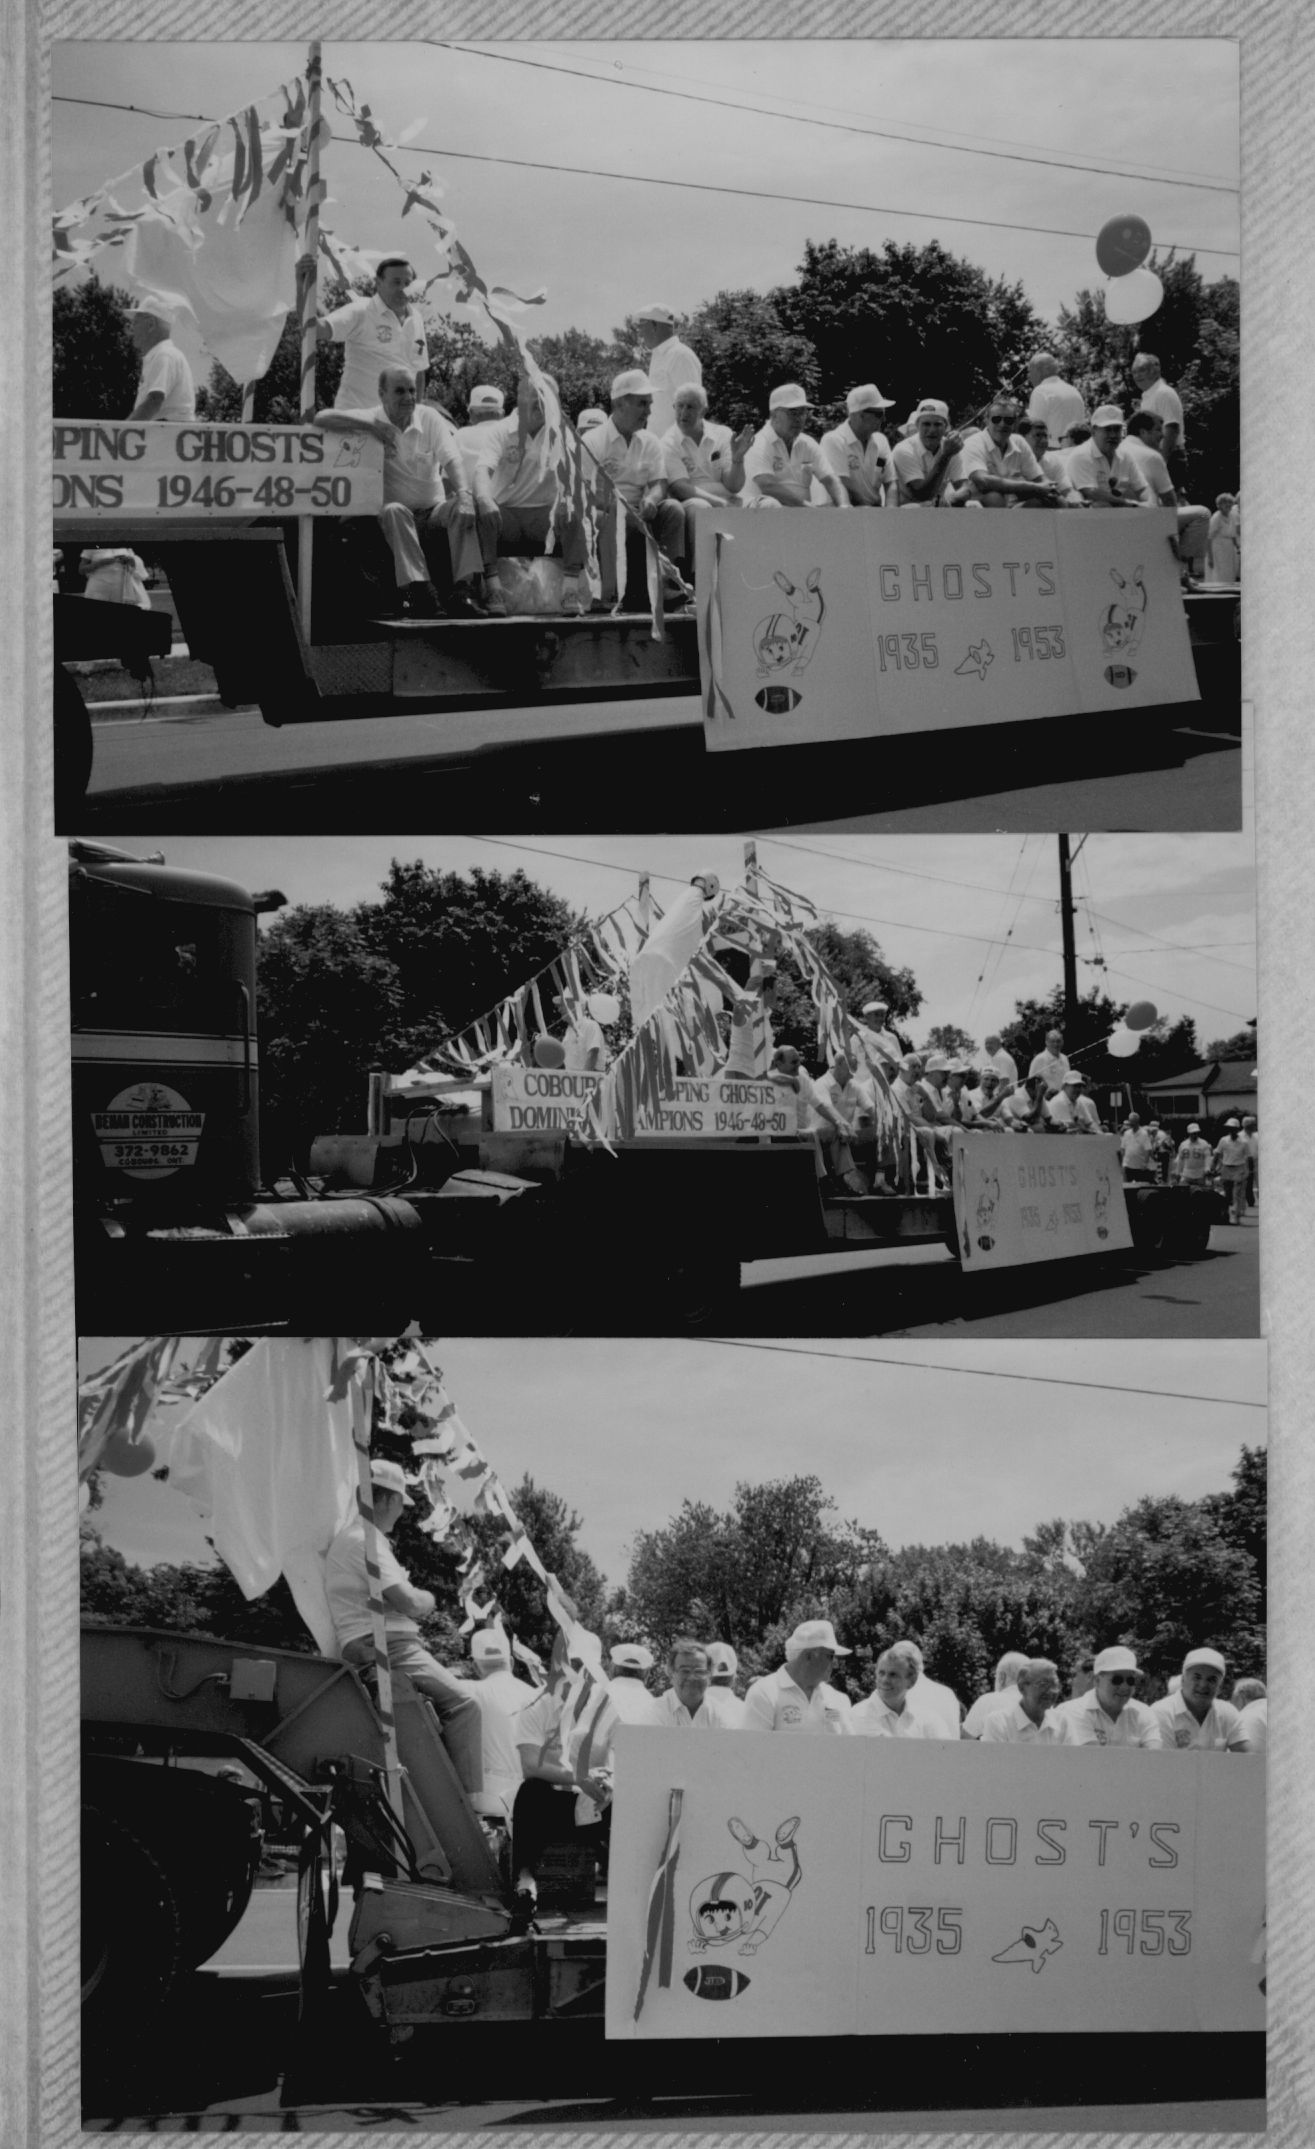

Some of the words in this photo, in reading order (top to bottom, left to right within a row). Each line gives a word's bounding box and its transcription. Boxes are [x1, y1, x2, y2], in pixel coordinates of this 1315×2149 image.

[53, 426, 147, 461] PING
[175, 429, 324, 463] GHOSTS
[157, 475, 352, 508] 1946-48-50
[878, 561, 1057, 602] GHOST'S
[876, 632, 940, 673] 1935
[1010, 625, 1067, 662] 1953
[719, 1083, 776, 1104] GHOSTS
[132, 1114, 202, 1128] CONSTRUCTION
[714, 1111, 786, 1132] 1946-48-50
[114, 1144, 189, 1157] 372-9862
[1018, 1164, 1077, 1189] GHOST'S
[878, 1814, 1181, 1869] GHOST'S
[864, 1906, 964, 1956] 1935
[1098, 1909, 1193, 1956] 1953
